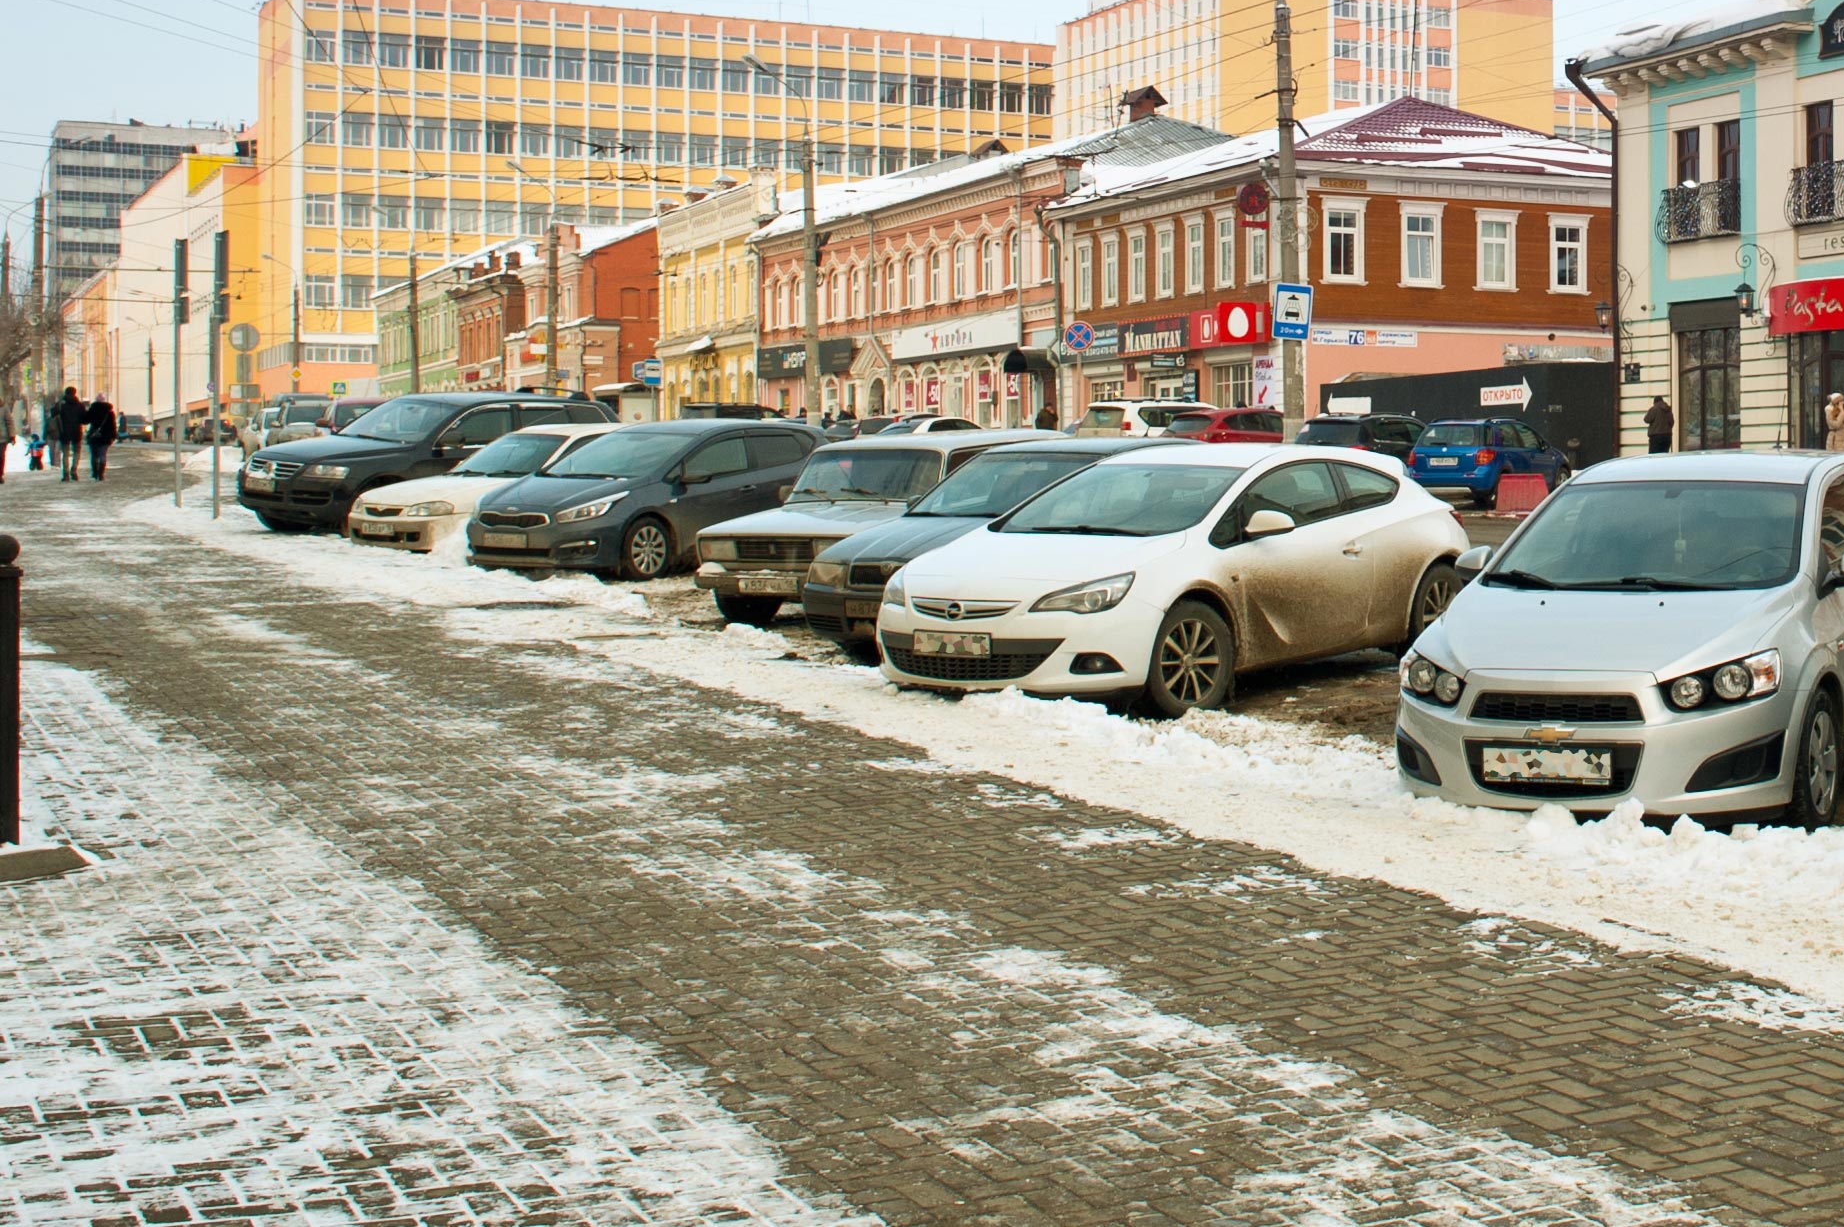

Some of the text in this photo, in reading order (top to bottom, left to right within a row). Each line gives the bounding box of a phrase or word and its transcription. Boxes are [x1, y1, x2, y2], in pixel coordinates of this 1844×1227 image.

[1785, 285, 1844, 326] Pasta
[940, 328, 973, 349] АВРОРА
[1124, 329, 1182, 352] MANHATTAN
[1350, 331, 1364, 343] 76
[1483, 388, 1523, 401] ОТКРЫТО
